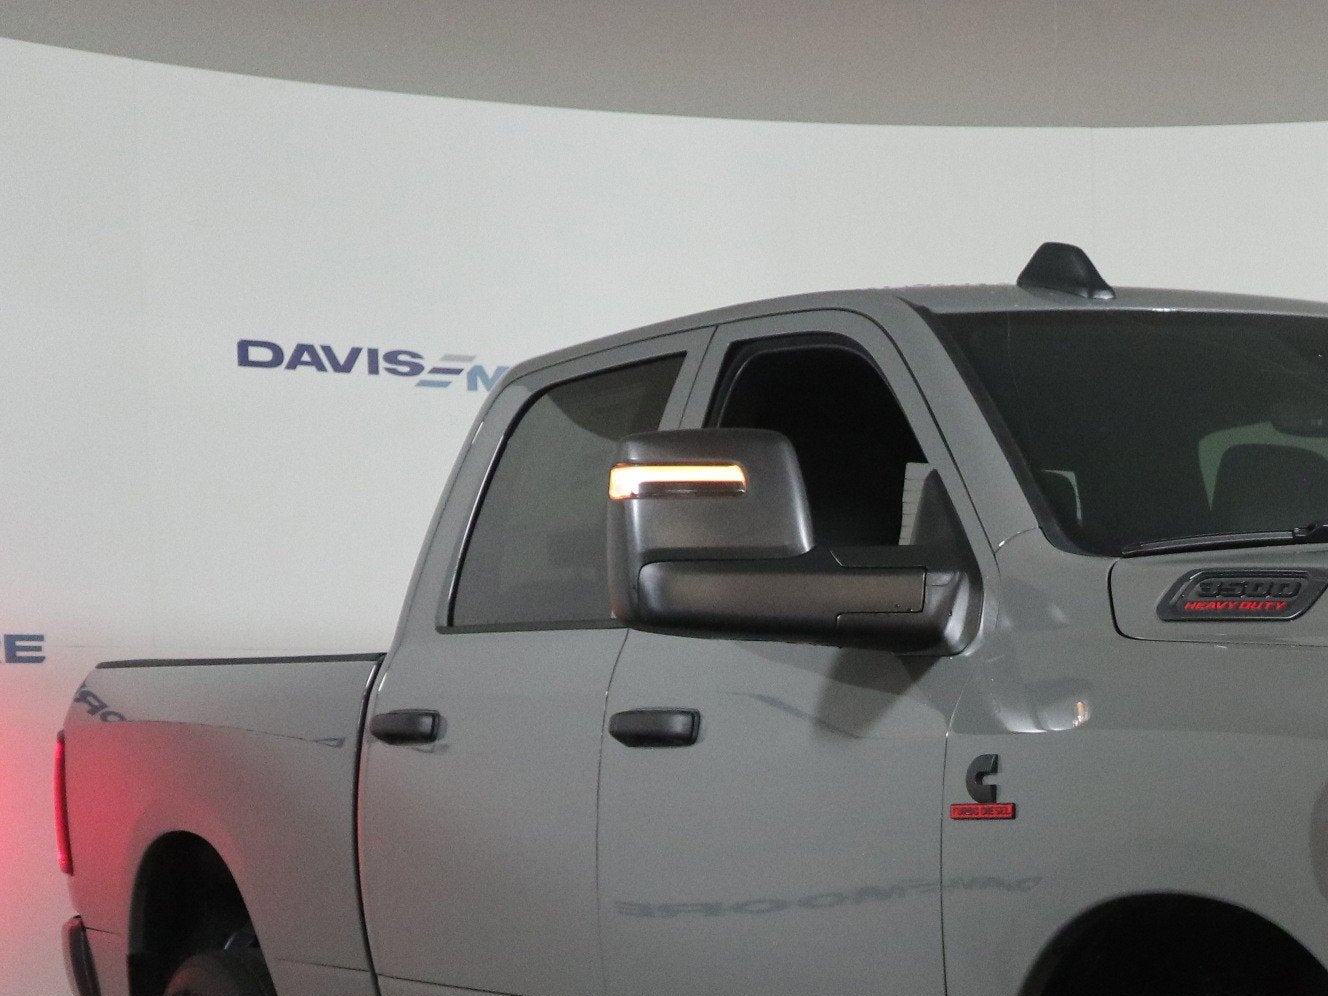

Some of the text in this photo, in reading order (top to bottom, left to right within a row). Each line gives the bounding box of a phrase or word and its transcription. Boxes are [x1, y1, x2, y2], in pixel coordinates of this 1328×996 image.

[237, 339, 426, 377] DAVIS
[1184, 601, 1288, 611] HEAVY DUTY
